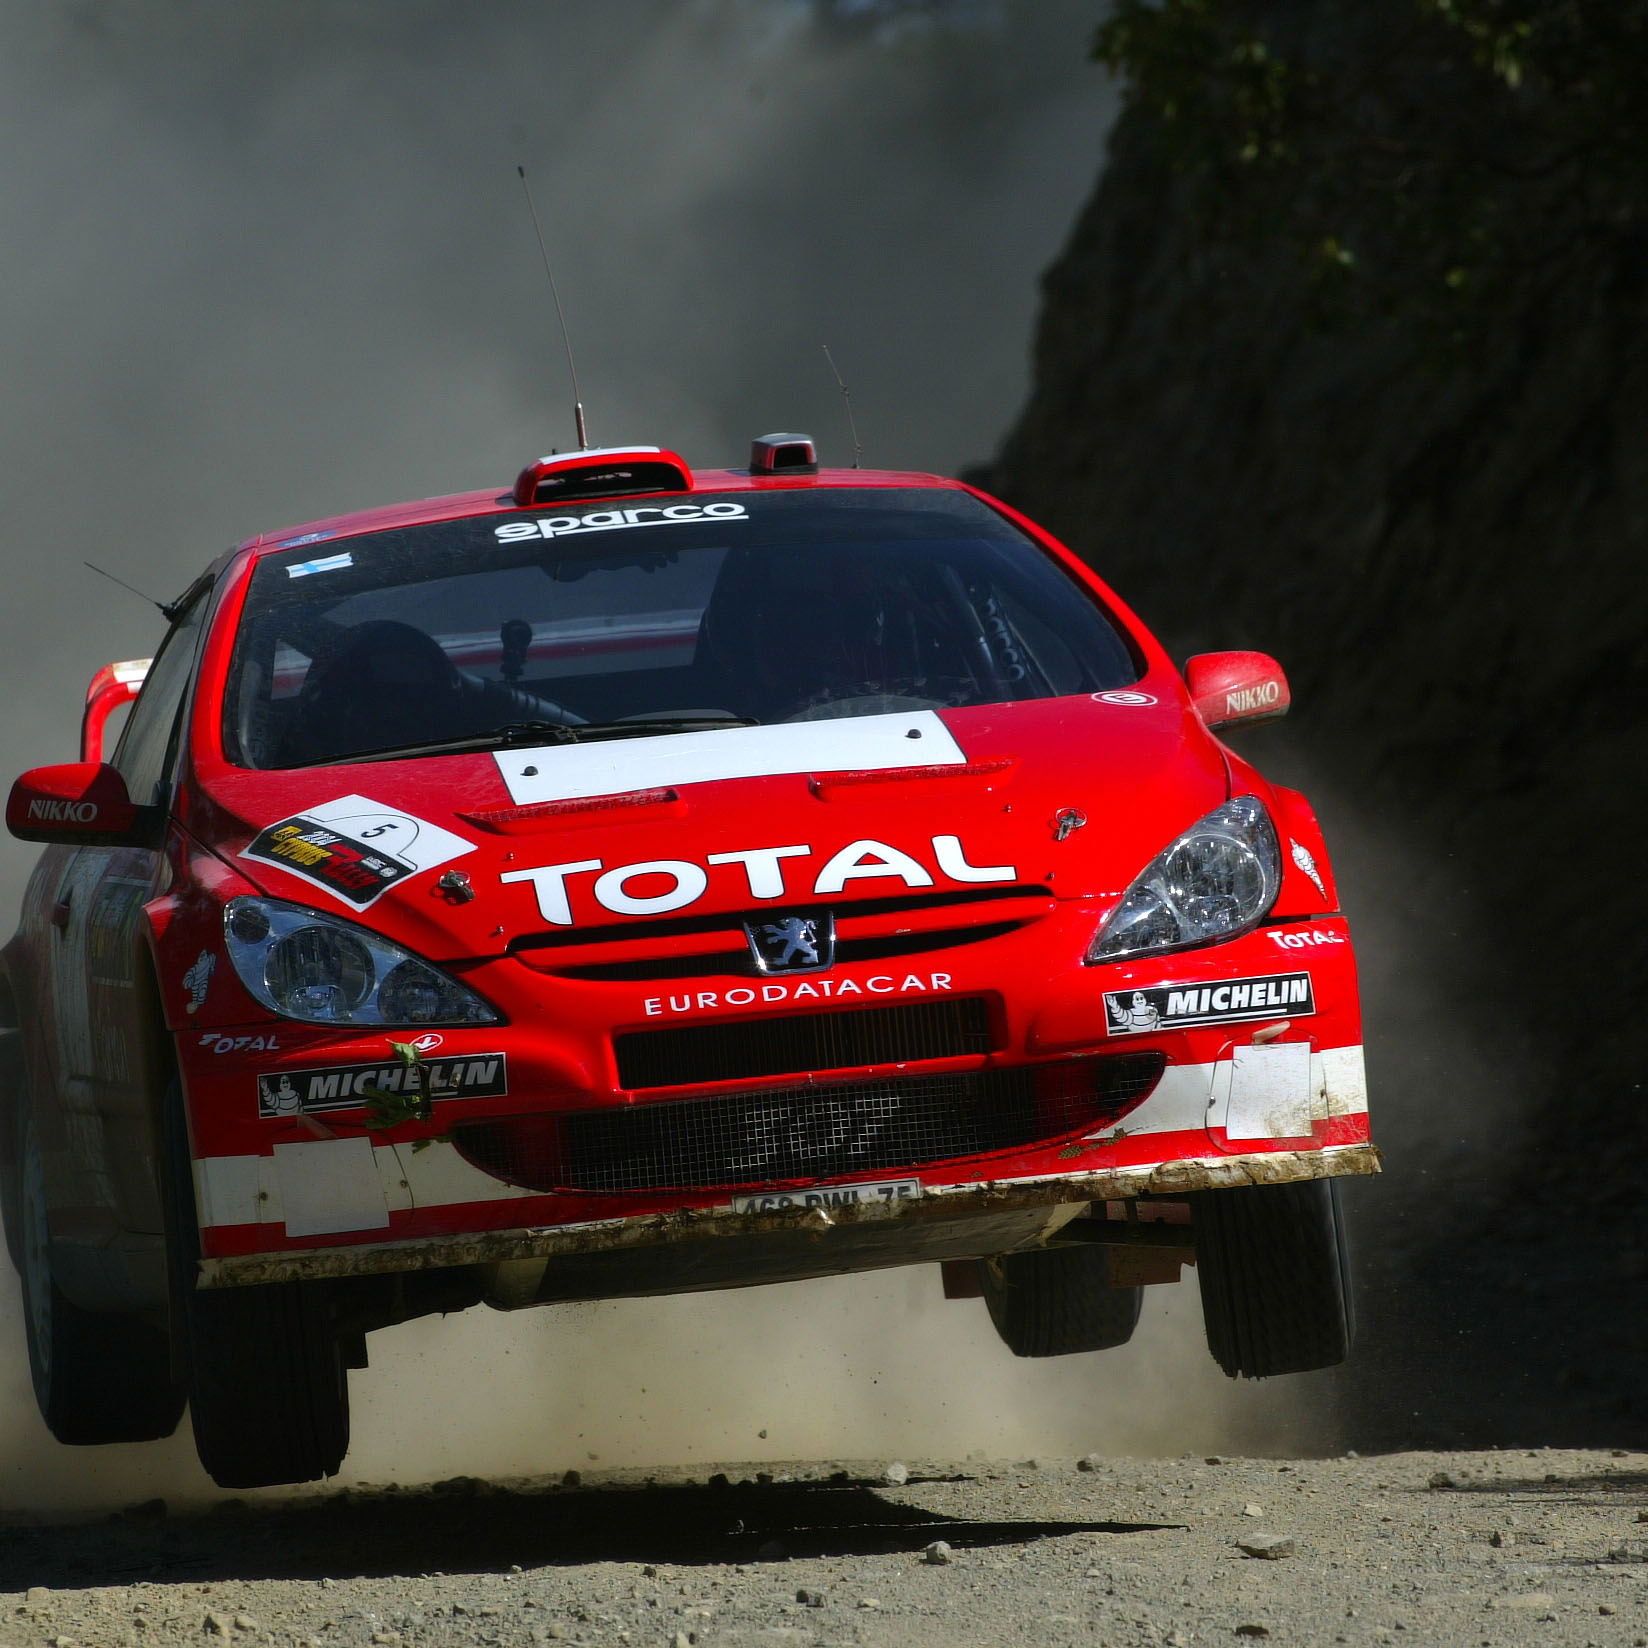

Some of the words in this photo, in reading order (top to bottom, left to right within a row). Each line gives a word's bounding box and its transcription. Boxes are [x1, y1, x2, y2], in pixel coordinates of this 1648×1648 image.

[494, 502, 749, 543] sparco
[1226, 681, 1279, 715] NIKKO
[27, 799, 98, 823] NIKKO
[360, 822, 399, 839] 5
[499, 834, 1018, 926] TOTAL
[1267, 930, 1345, 950] TOTAL
[644, 972, 953, 1017] EURODATACAR
[1165, 978, 1308, 1016] MICHELIN
[199, 1032, 280, 1055] TOTAL
